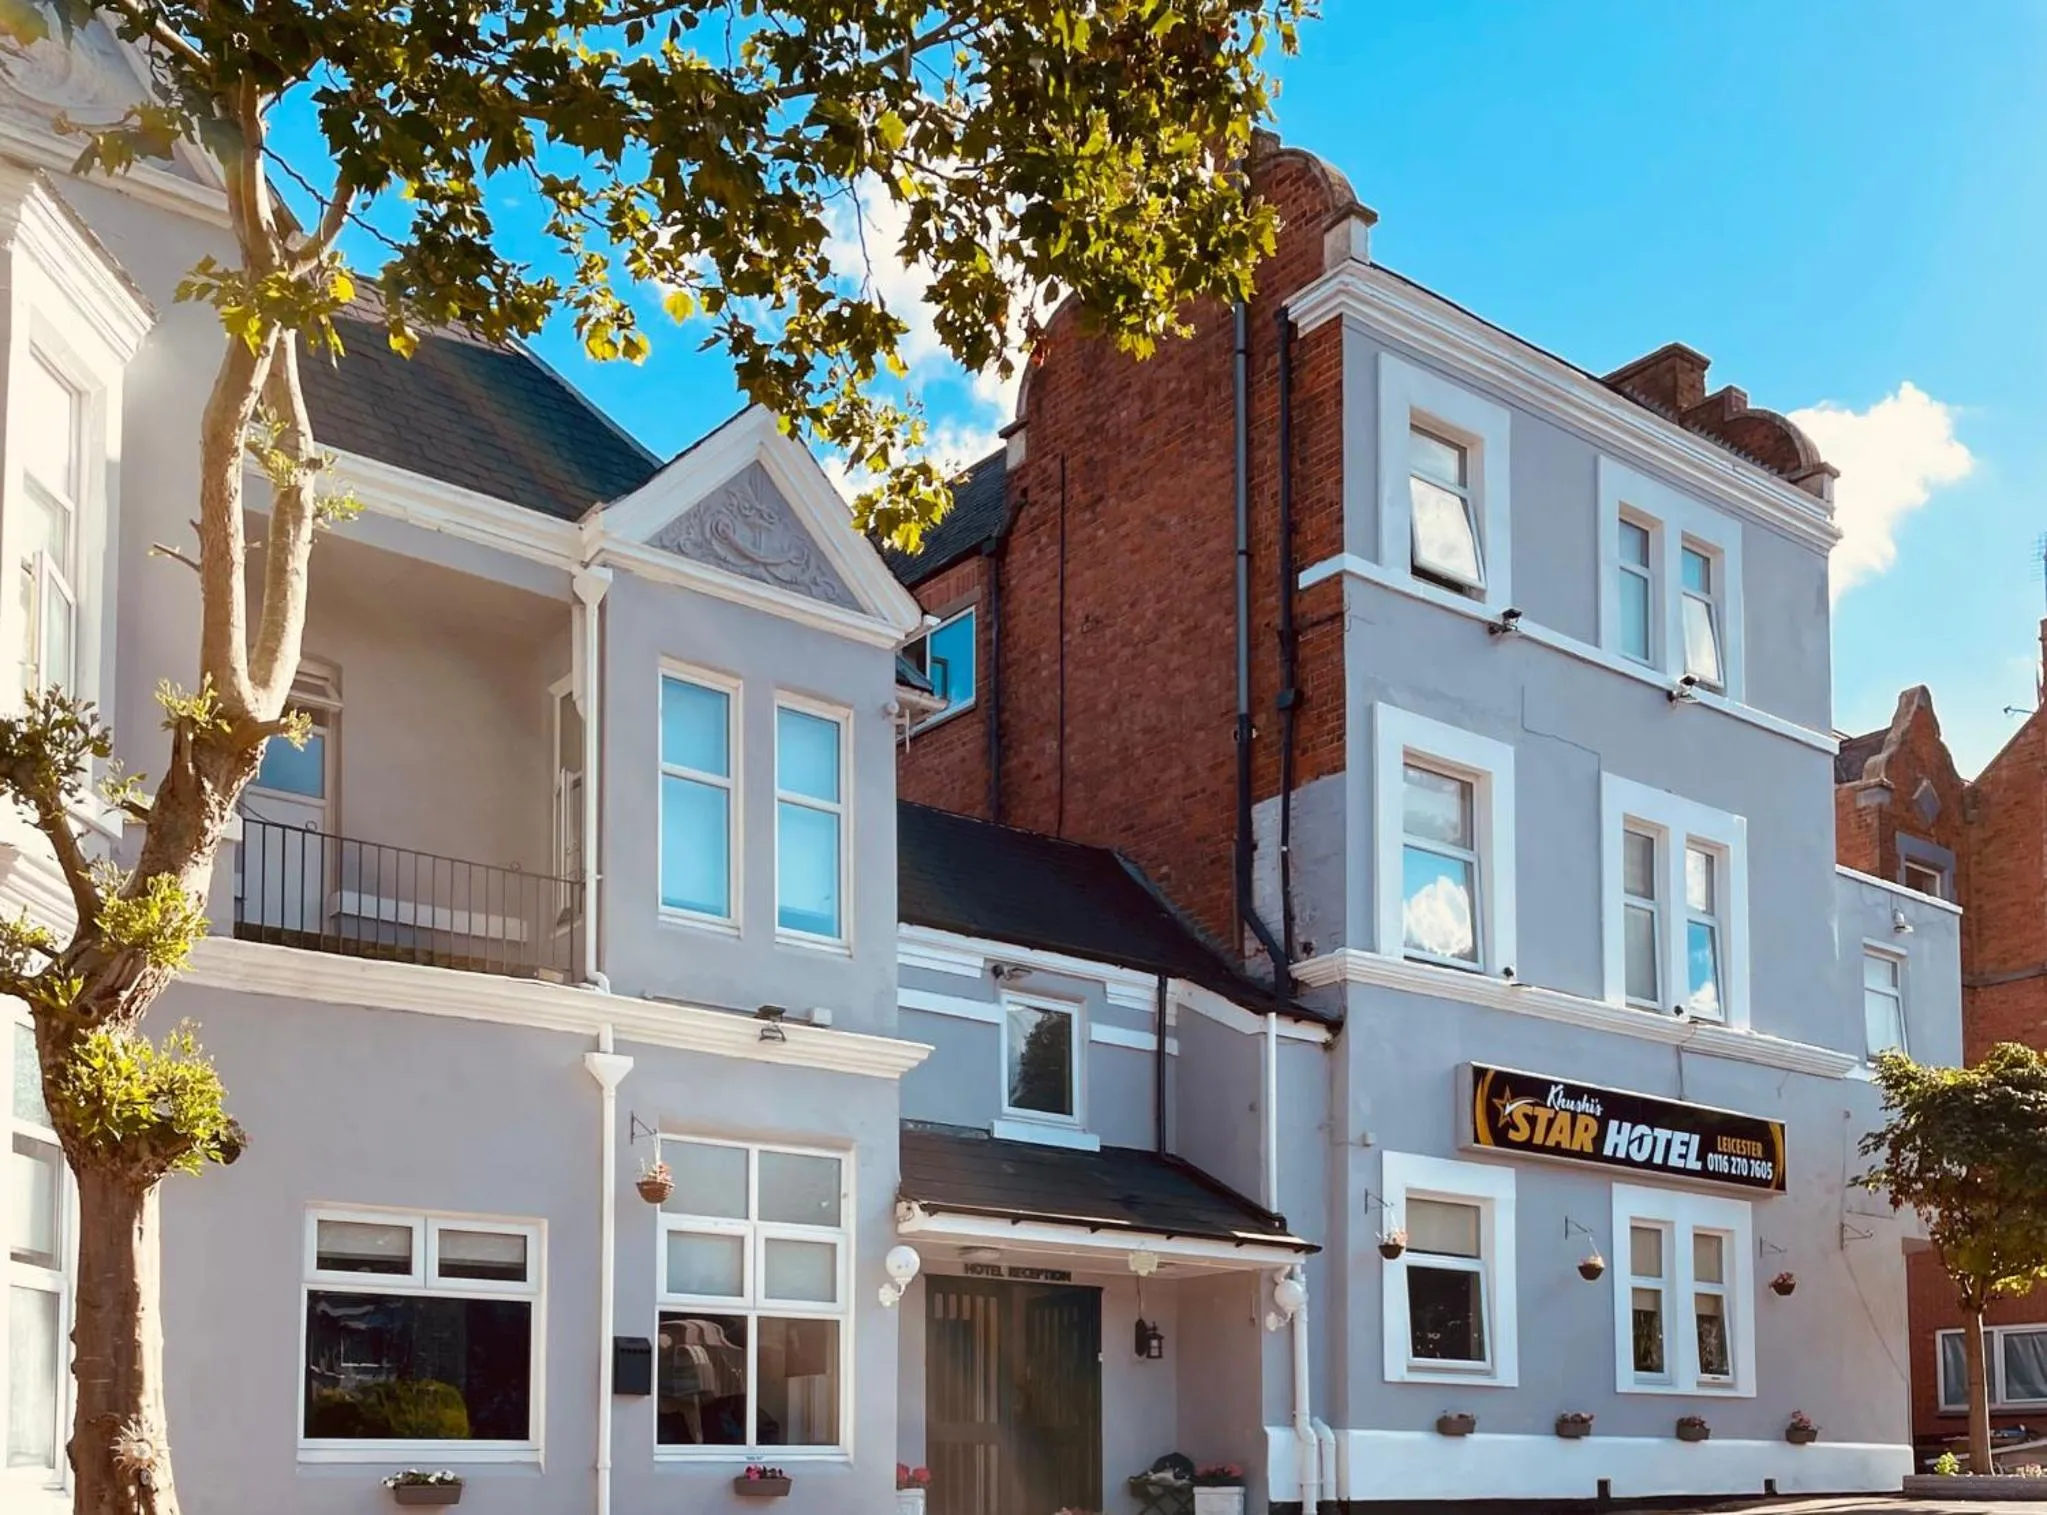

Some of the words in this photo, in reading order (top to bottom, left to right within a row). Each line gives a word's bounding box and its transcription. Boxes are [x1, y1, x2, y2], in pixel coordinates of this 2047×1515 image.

[1546, 1084, 1604, 1116] Khushi's
[1508, 1103, 1598, 1153] STAR
[1603, 1119, 1702, 1170] HOTEL
[1717, 1135, 1763, 1158] LEICESTER
[1707, 1152, 1729, 1172] 0116
[1730, 1156, 1749, 1177] 270
[1750, 1159, 1773, 1180] 7605
[964, 1263, 1004, 1277] HOTEL
[1008, 1267, 1072, 1282] RECEPTION
